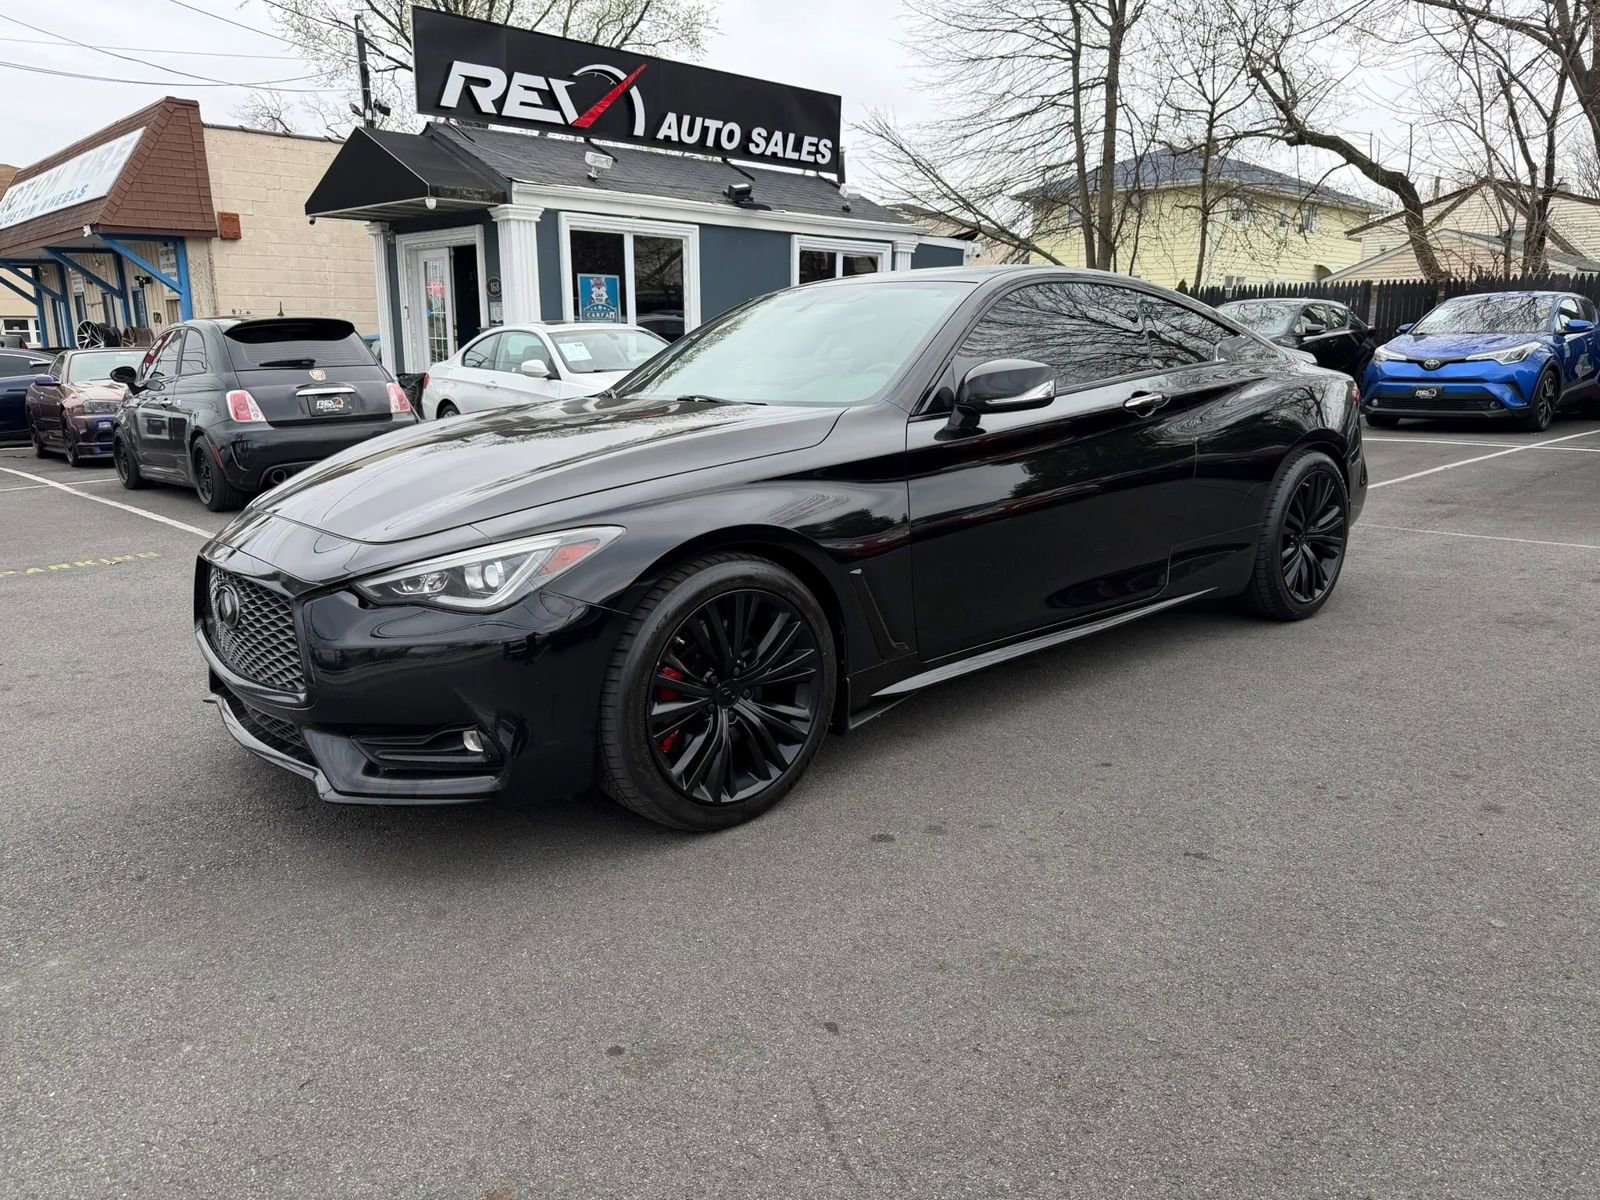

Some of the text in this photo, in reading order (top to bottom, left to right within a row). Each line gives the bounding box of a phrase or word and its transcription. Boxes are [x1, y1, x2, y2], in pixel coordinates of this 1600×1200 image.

[440, 60, 648, 137] REV
[656, 111, 833, 165] AUTO SALES
